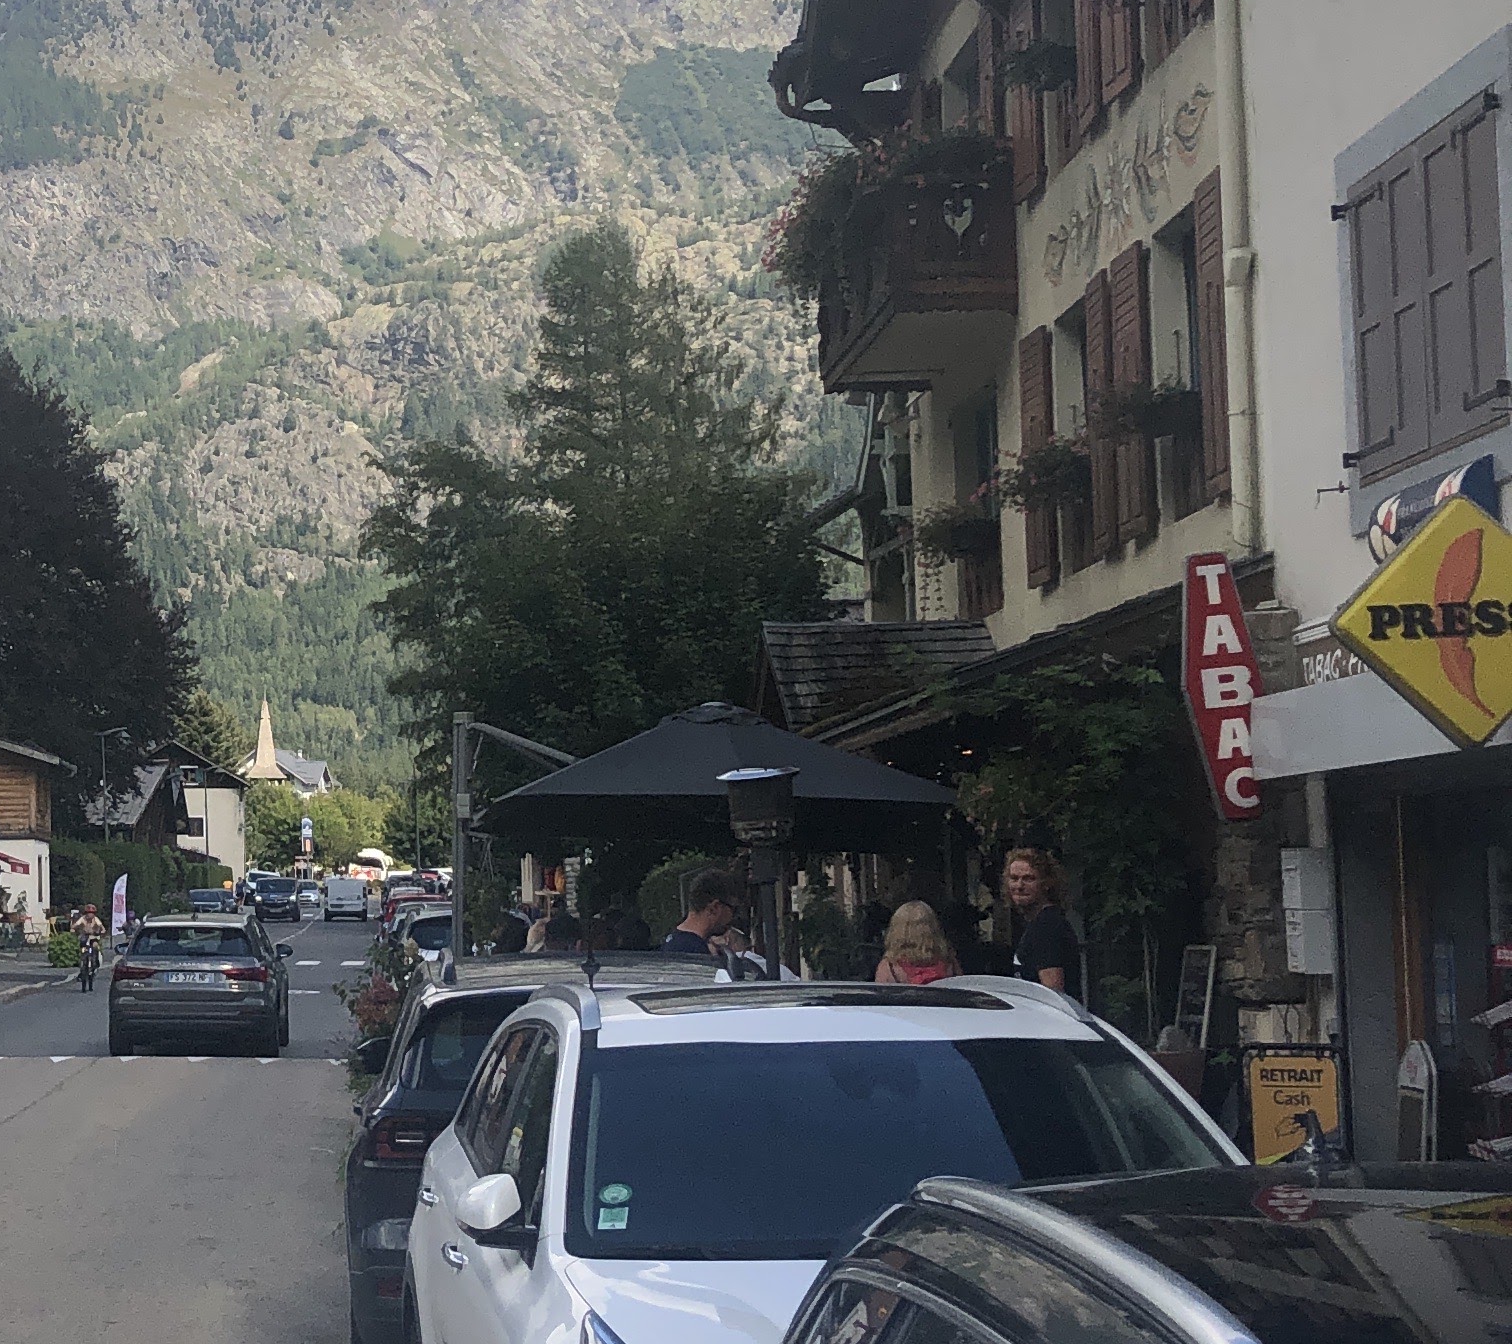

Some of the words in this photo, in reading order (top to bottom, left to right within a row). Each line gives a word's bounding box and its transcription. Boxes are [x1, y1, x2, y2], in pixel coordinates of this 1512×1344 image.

[1367, 599, 1512, 641] PRES
[1302, 648, 1342, 685] TABAC
[1196, 563, 1260, 808] TABAC
[1259, 1068, 1323, 1083] RETRAIT
[1273, 1089, 1312, 1106] Cash
